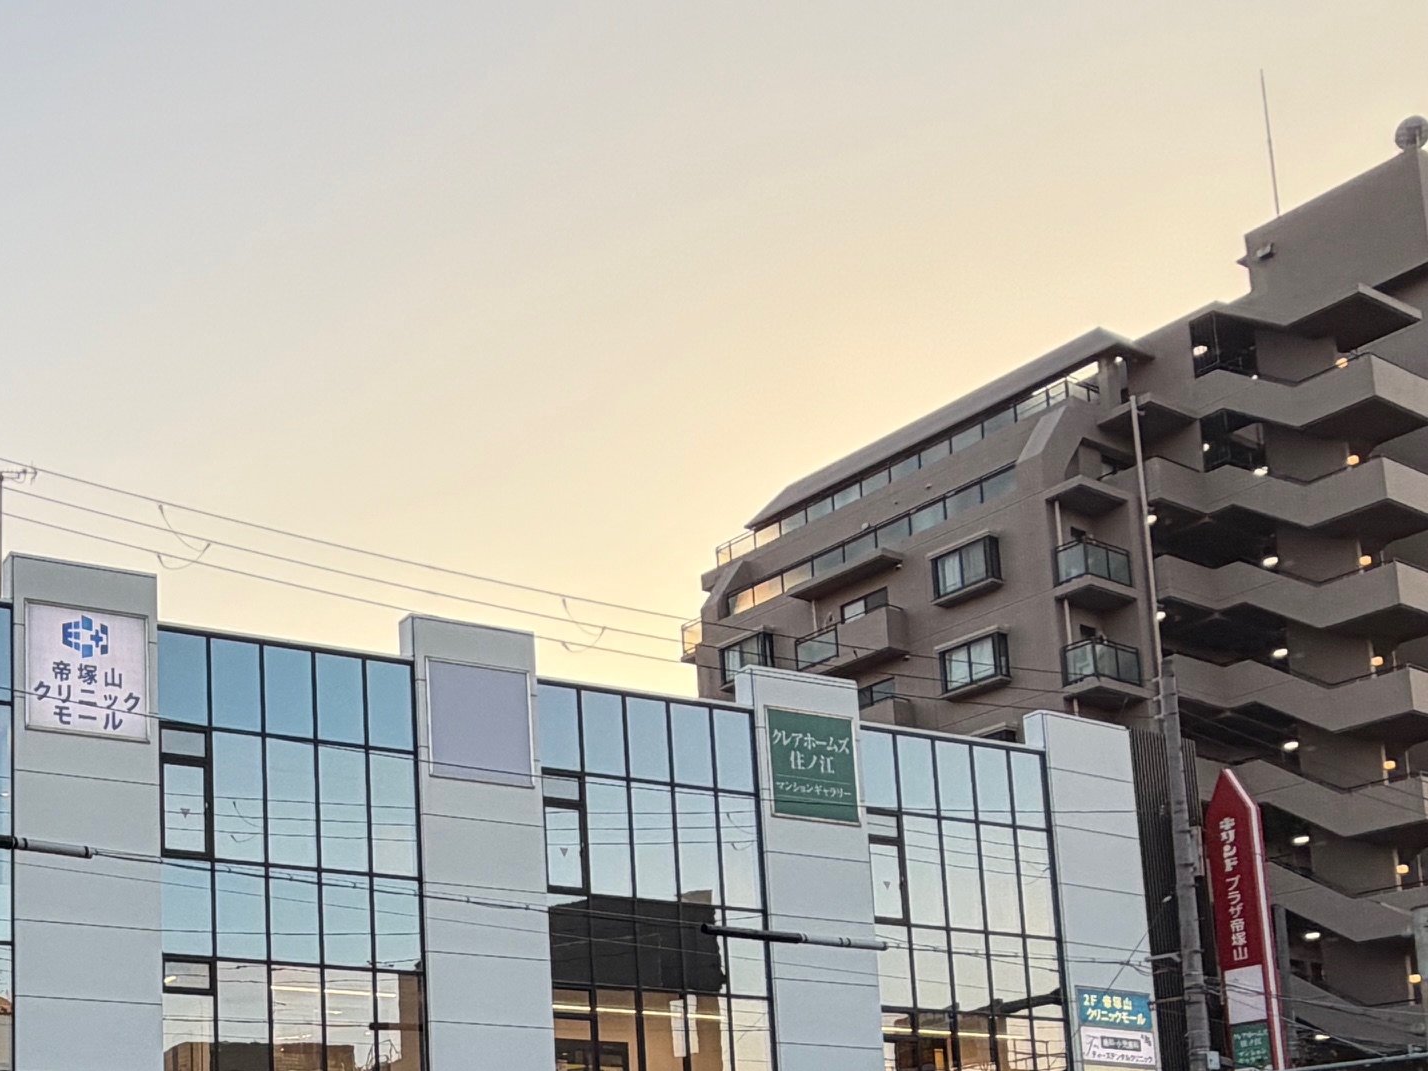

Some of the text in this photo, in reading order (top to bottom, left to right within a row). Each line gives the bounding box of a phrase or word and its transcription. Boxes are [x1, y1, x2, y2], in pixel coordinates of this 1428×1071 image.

[52, 660, 123, 689] 帝塚山
[34, 681, 141, 714] クリニック
[53, 705, 123, 731] モール
